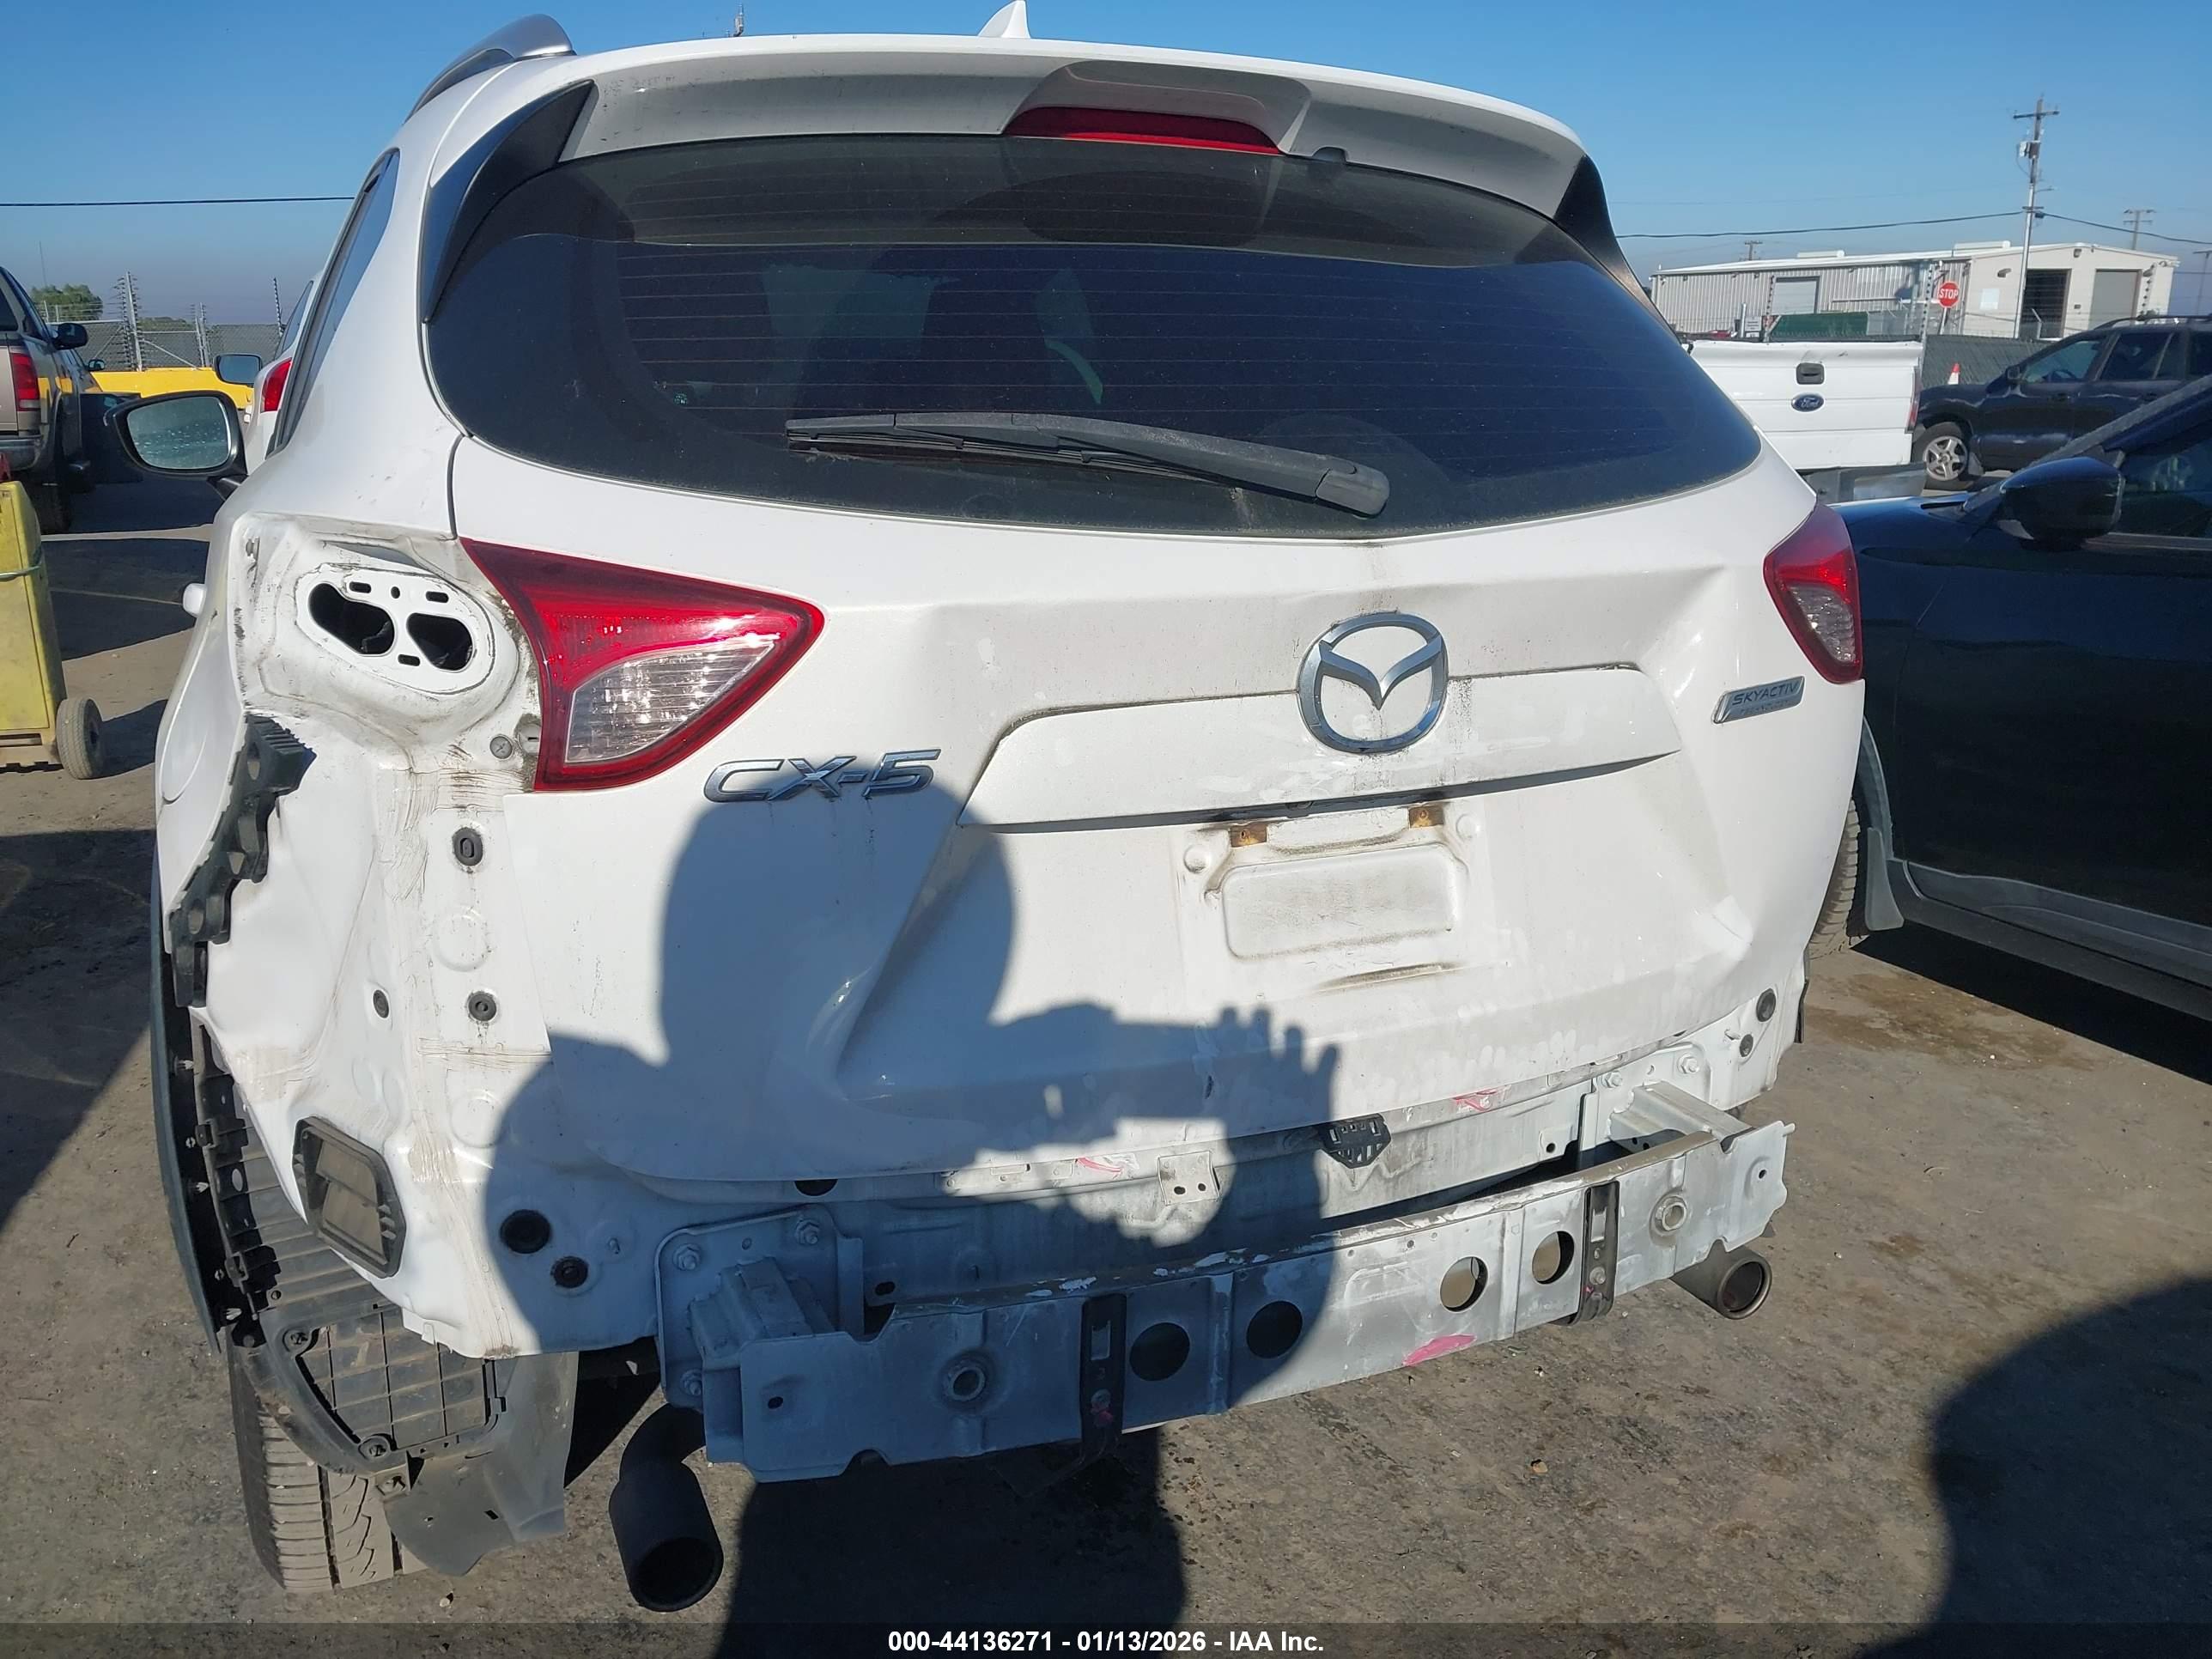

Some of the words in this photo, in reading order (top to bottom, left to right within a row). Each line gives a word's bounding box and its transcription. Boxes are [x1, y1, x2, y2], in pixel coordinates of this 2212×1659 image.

[1939, 288, 1959, 300] STOP
[1799, 396, 1820, 409] Ford
[1731, 680, 1800, 706] SKYACTIV
[703, 748, 942, 803] CX-5
